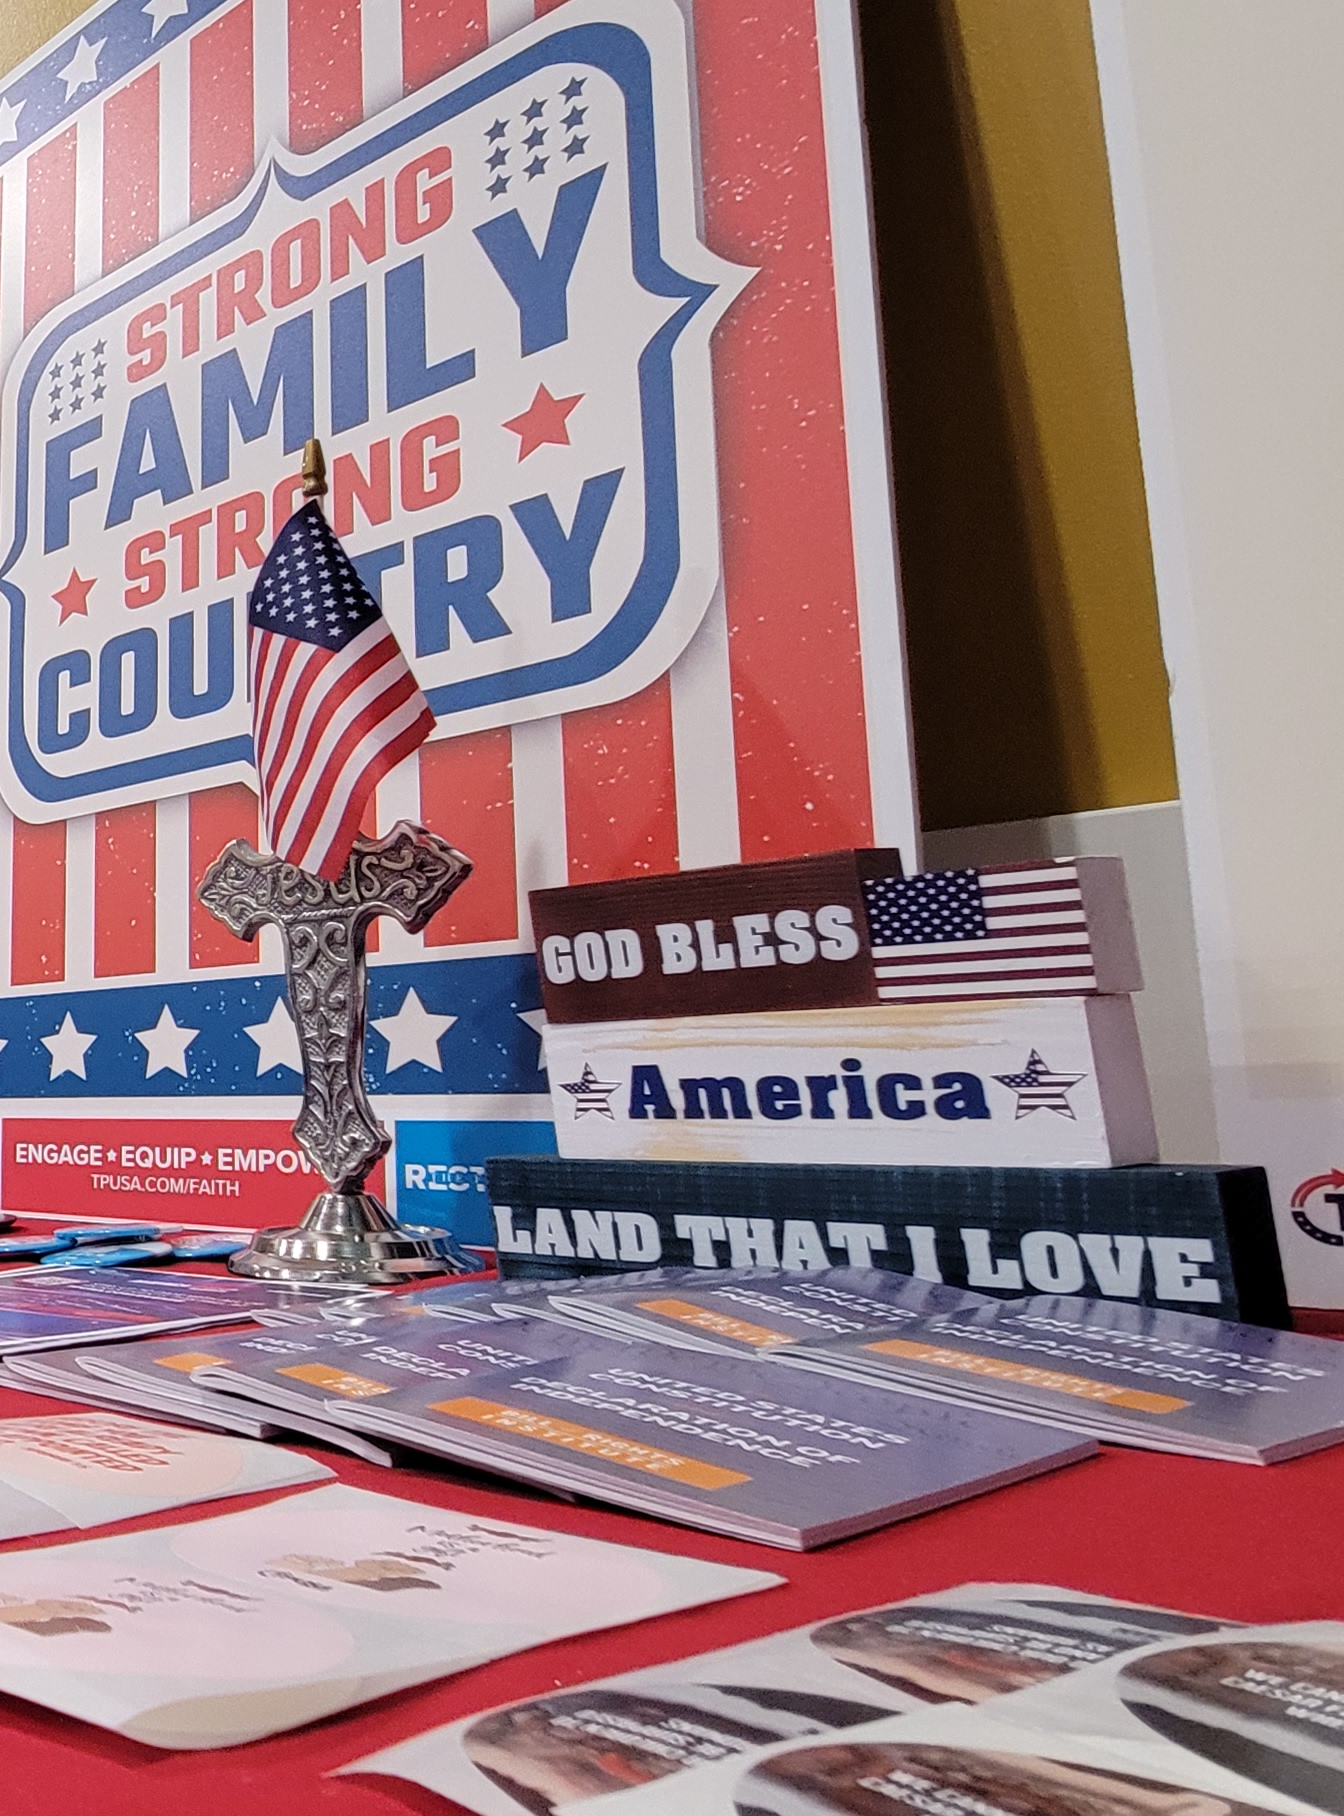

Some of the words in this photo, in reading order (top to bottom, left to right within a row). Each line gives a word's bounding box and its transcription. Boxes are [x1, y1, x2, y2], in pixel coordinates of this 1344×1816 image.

[125, 145, 453, 384] STRONG
[44, 162, 609, 555] FAMILY
[37, 466, 625, 755] COURY
[541, 927, 644, 986] GOD
[658, 904, 860, 976] BLESS
[628, 1056, 991, 1121] America
[15, 1143, 103, 1166] ENGAGE
[120, 1146, 197, 1169] EQUIP
[217, 1148, 319, 1175] EMPO
[90, 1173, 241, 1197] TPUSA.COM/FAITH
[494, 1206, 662, 1263] LAND
[673, 1214, 886, 1270] THAT
[905, 1225, 943, 1284] I
[960, 1228, 1222, 1304] LOVE
[711, 1290, 853, 1334] INDEPEN
[719, 1286, 865, 1330] DECLARA
[781, 1285, 910, 1322] CONSTI
[800, 1283, 918, 1318] UNITED
[363, 1353, 458, 1380] INDEP
[372, 1346, 471, 1377] DECLA
[437, 1343, 521, 1370] CONS
[457, 1339, 540, 1366] UNIT
[930, 1327, 1258, 1396] INDEPENDENCE
[933, 1322, 1218, 1379] DECLARATION
[1224, 1378, 1289, 1393] OF
[1000, 1317, 1307, 1381] CONSTITUTION
[1014, 1314, 1159, 1343] UNITED
[1167, 1341, 1325, 1377] STATES
[510, 1382, 823, 1468] INDEPENDENCE
[519, 1376, 792, 1447] DECLARATION
[796, 1446, 861, 1464] OF
[589, 1373, 887, 1449] CONSTITUTION
[607, 1368, 747, 1401] UNITED
[749, 1400, 911, 1445] STATES
[580, 1432, 685, 1467] RIGHTS
